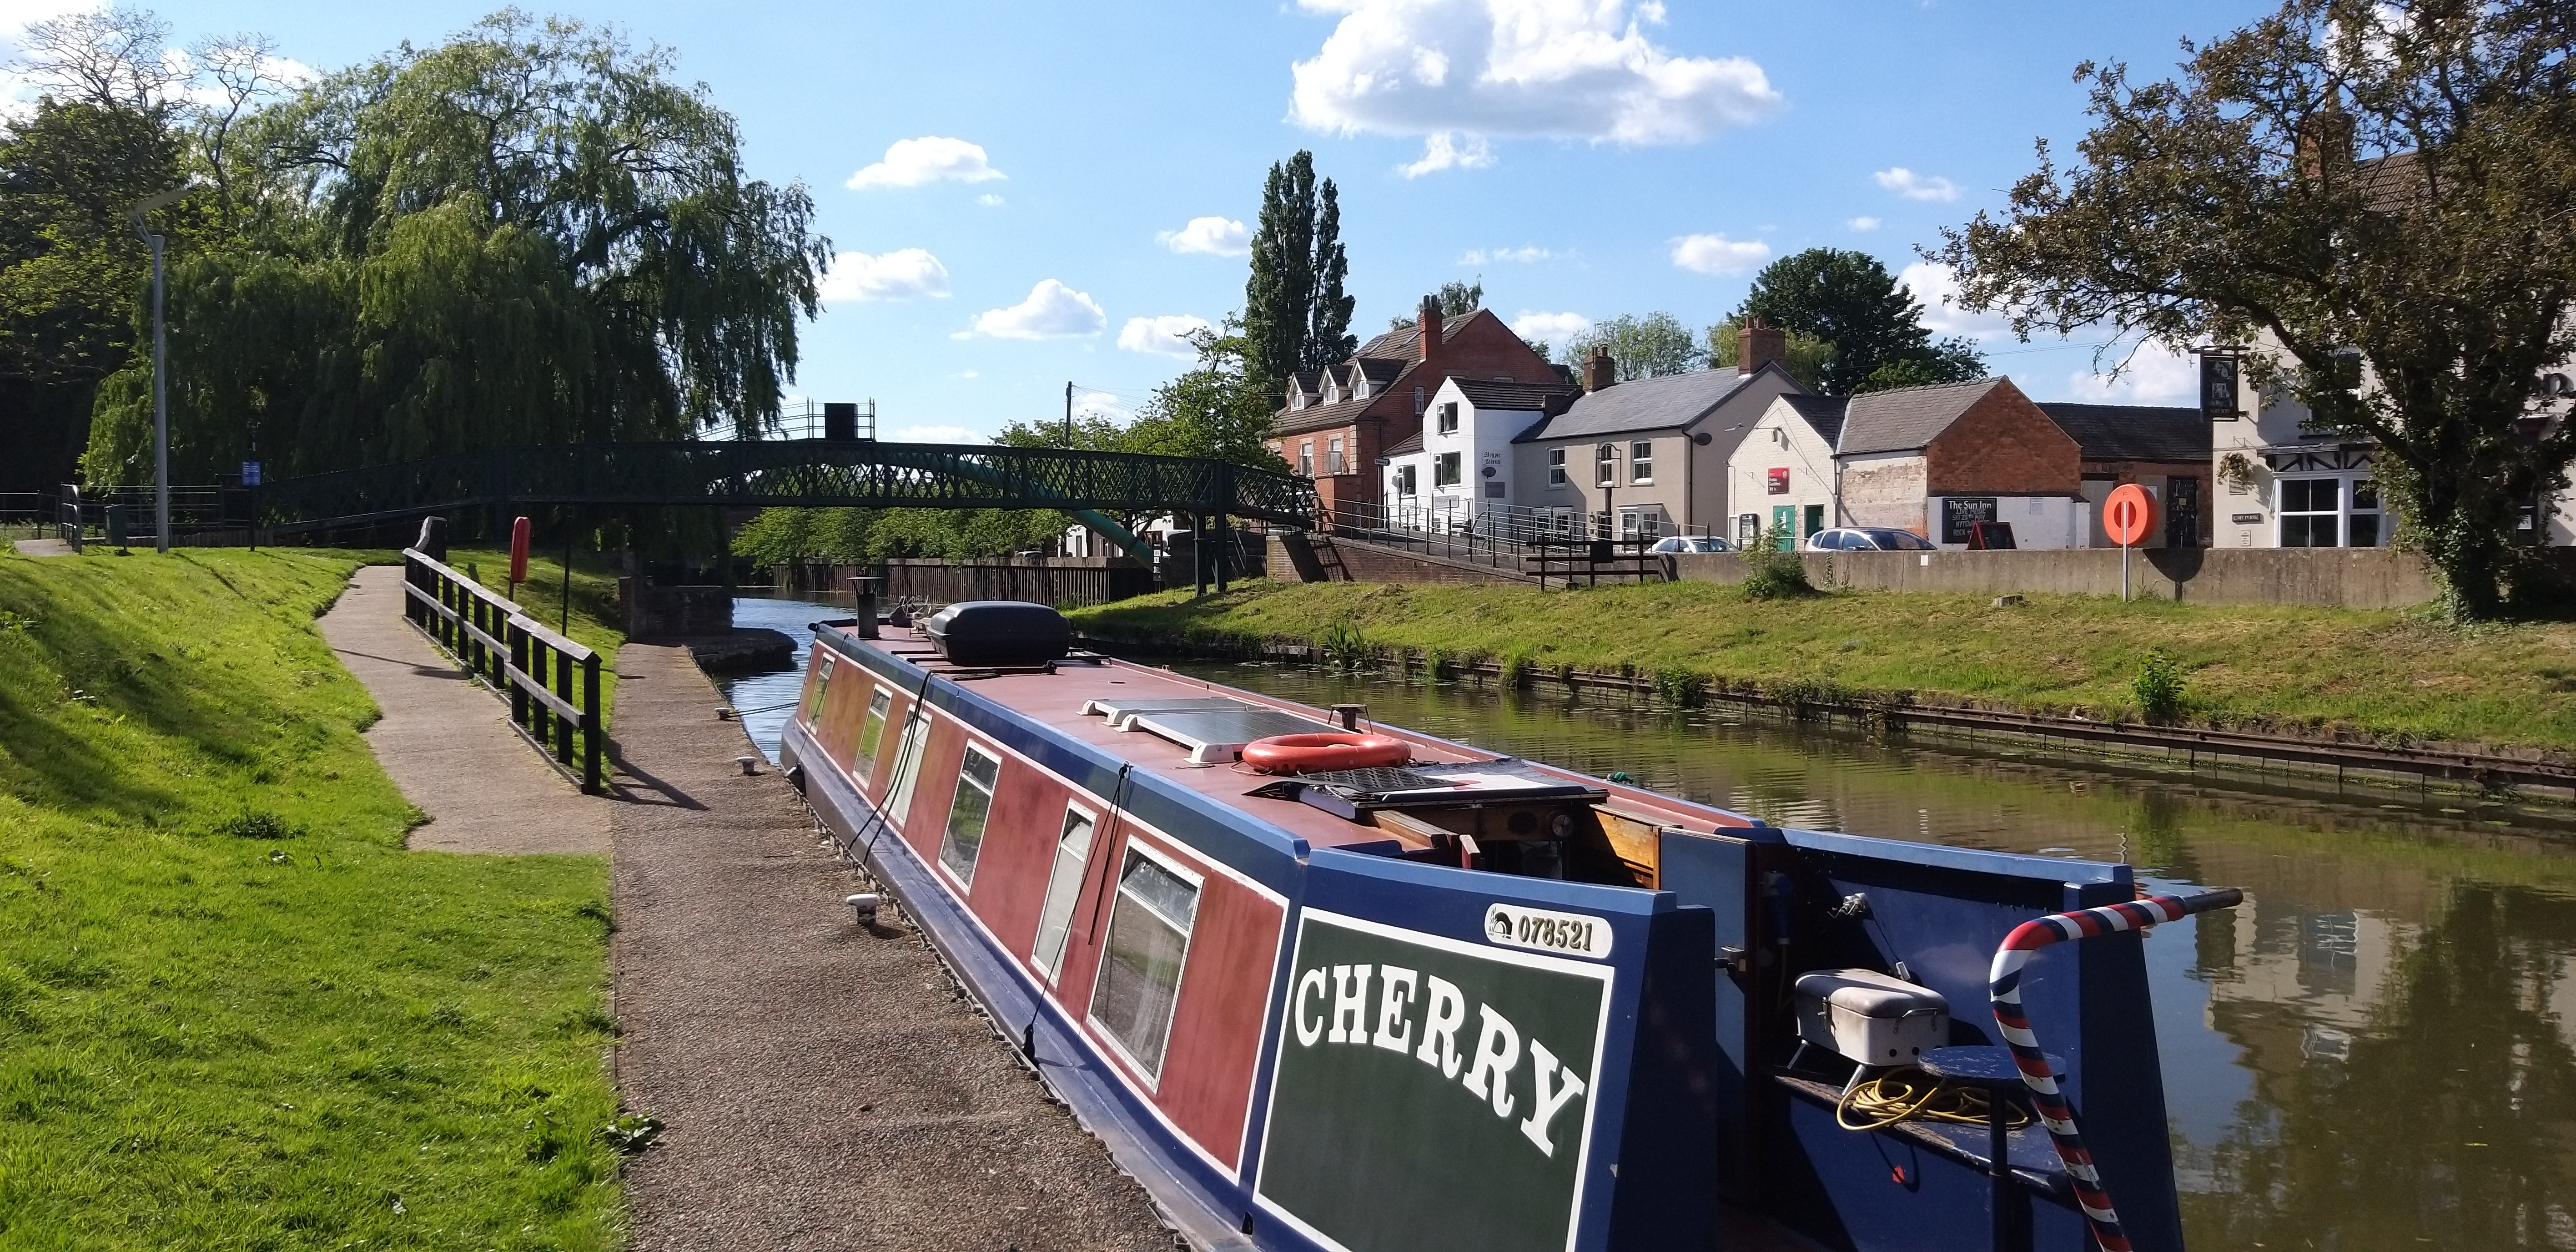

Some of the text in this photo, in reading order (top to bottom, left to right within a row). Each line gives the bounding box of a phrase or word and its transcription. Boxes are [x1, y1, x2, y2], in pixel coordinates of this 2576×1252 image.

[1947, 500, 1992, 510] The Sun Inn
[1518, 915, 1592, 952] 078521
[1295, 964, 1585, 1158] CHERRY
